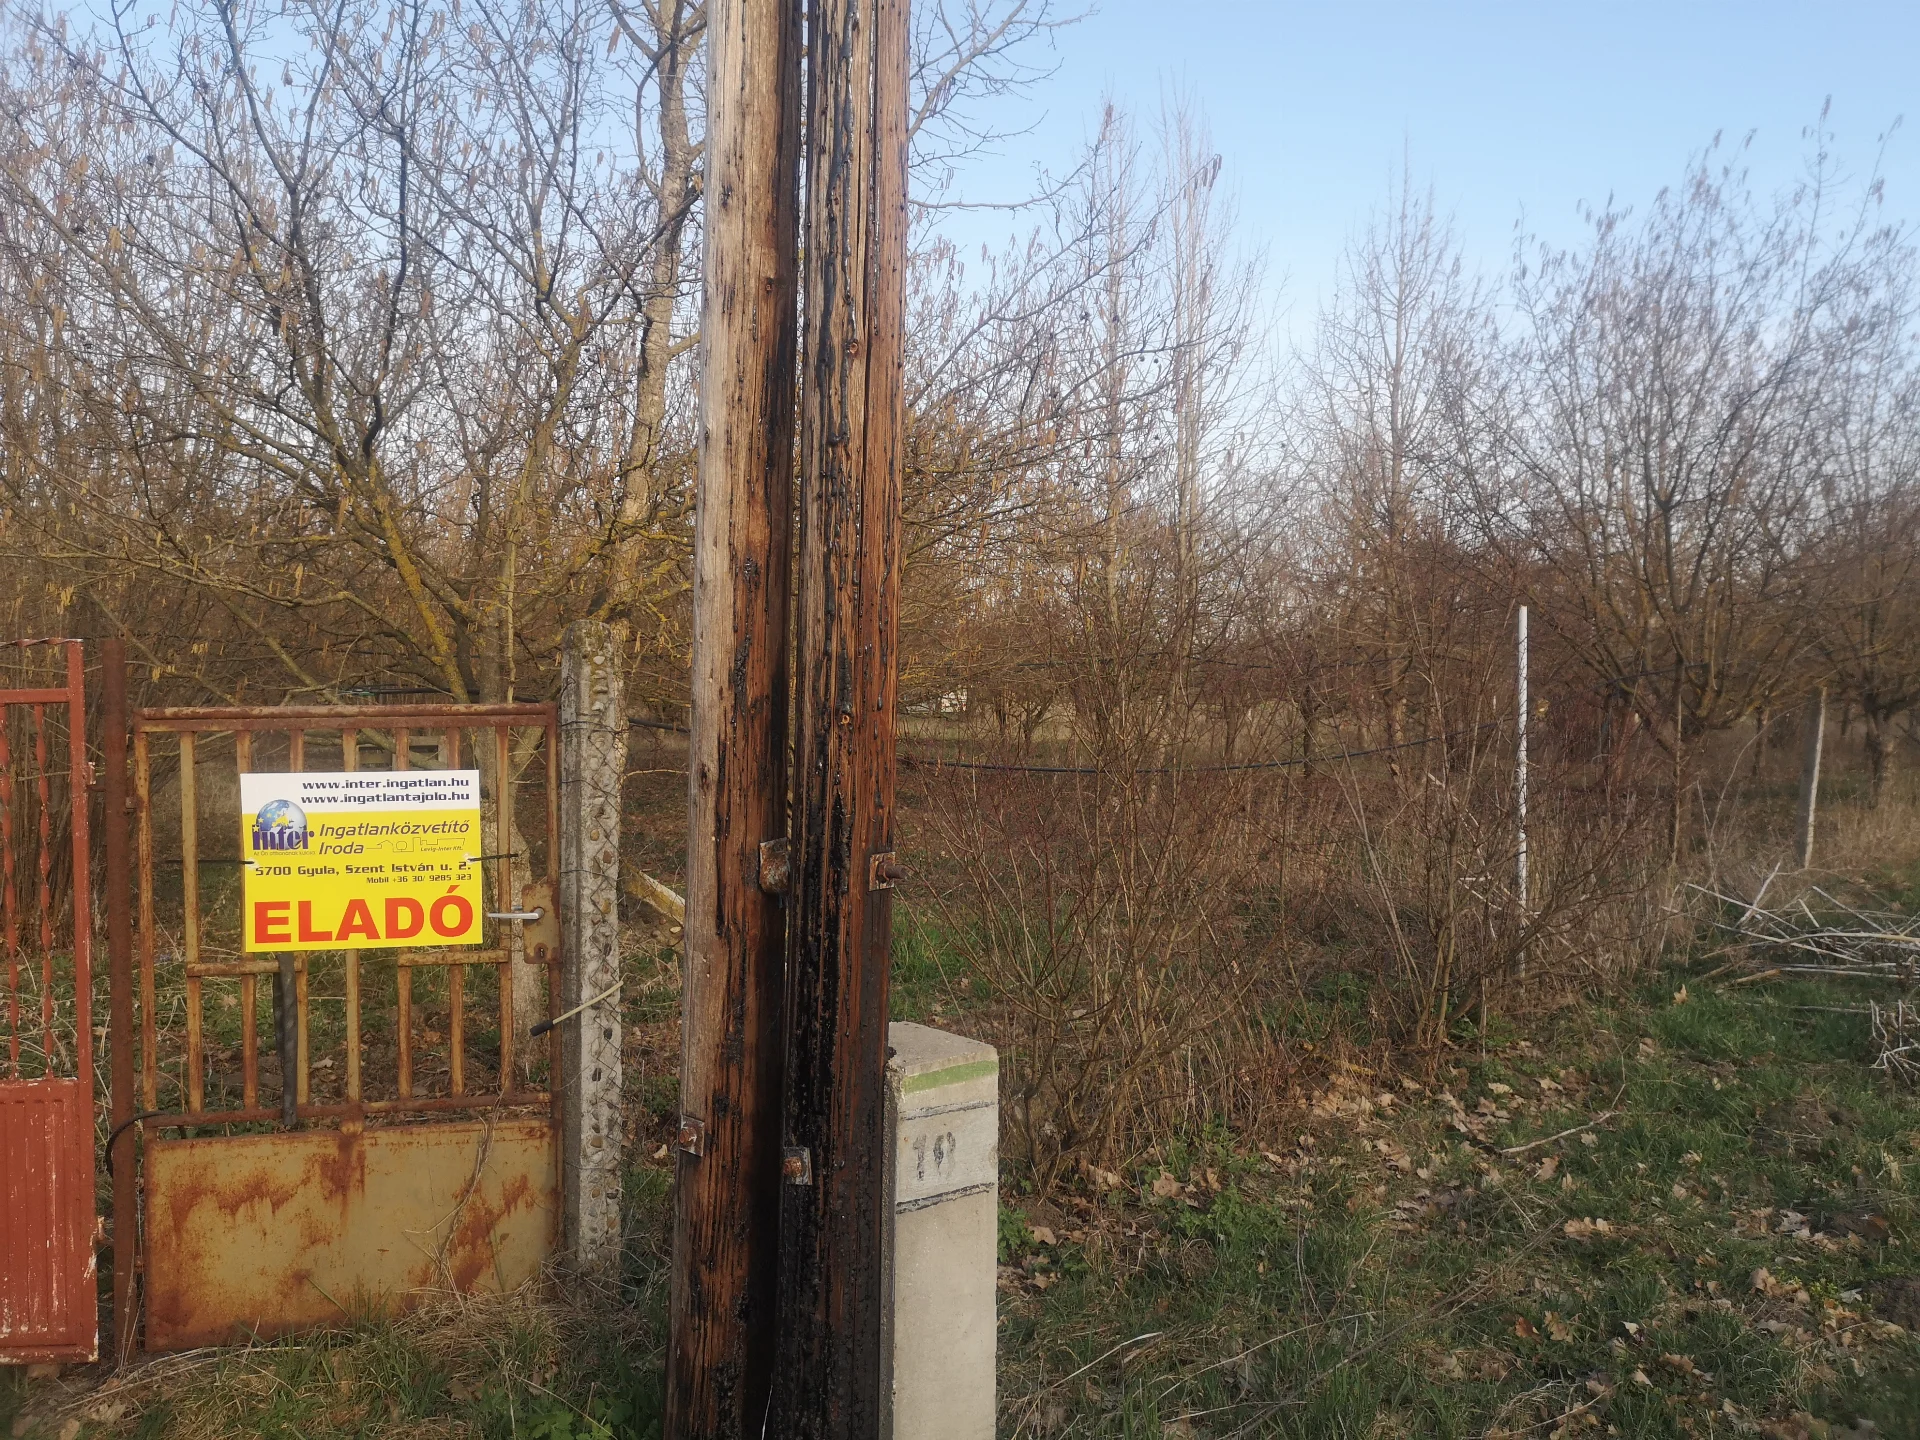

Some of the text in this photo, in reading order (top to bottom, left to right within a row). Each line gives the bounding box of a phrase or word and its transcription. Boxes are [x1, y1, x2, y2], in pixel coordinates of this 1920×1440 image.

[303, 778, 469, 790] www.inter.ingatlan.hu
[301, 792, 470, 804] www.ingatlantajolo.hu
[319, 820, 470, 839] Ingatlanközvetítő
[319, 842, 364, 855] Iroda
[255, 862, 471, 877] 5700 Gyula, Szent István u. 2.
[366, 875, 389, 884] Mobil
[393, 875, 408, 883] +36
[429, 874, 452, 882] 9285
[254, 885, 473, 943] ELADÓ
